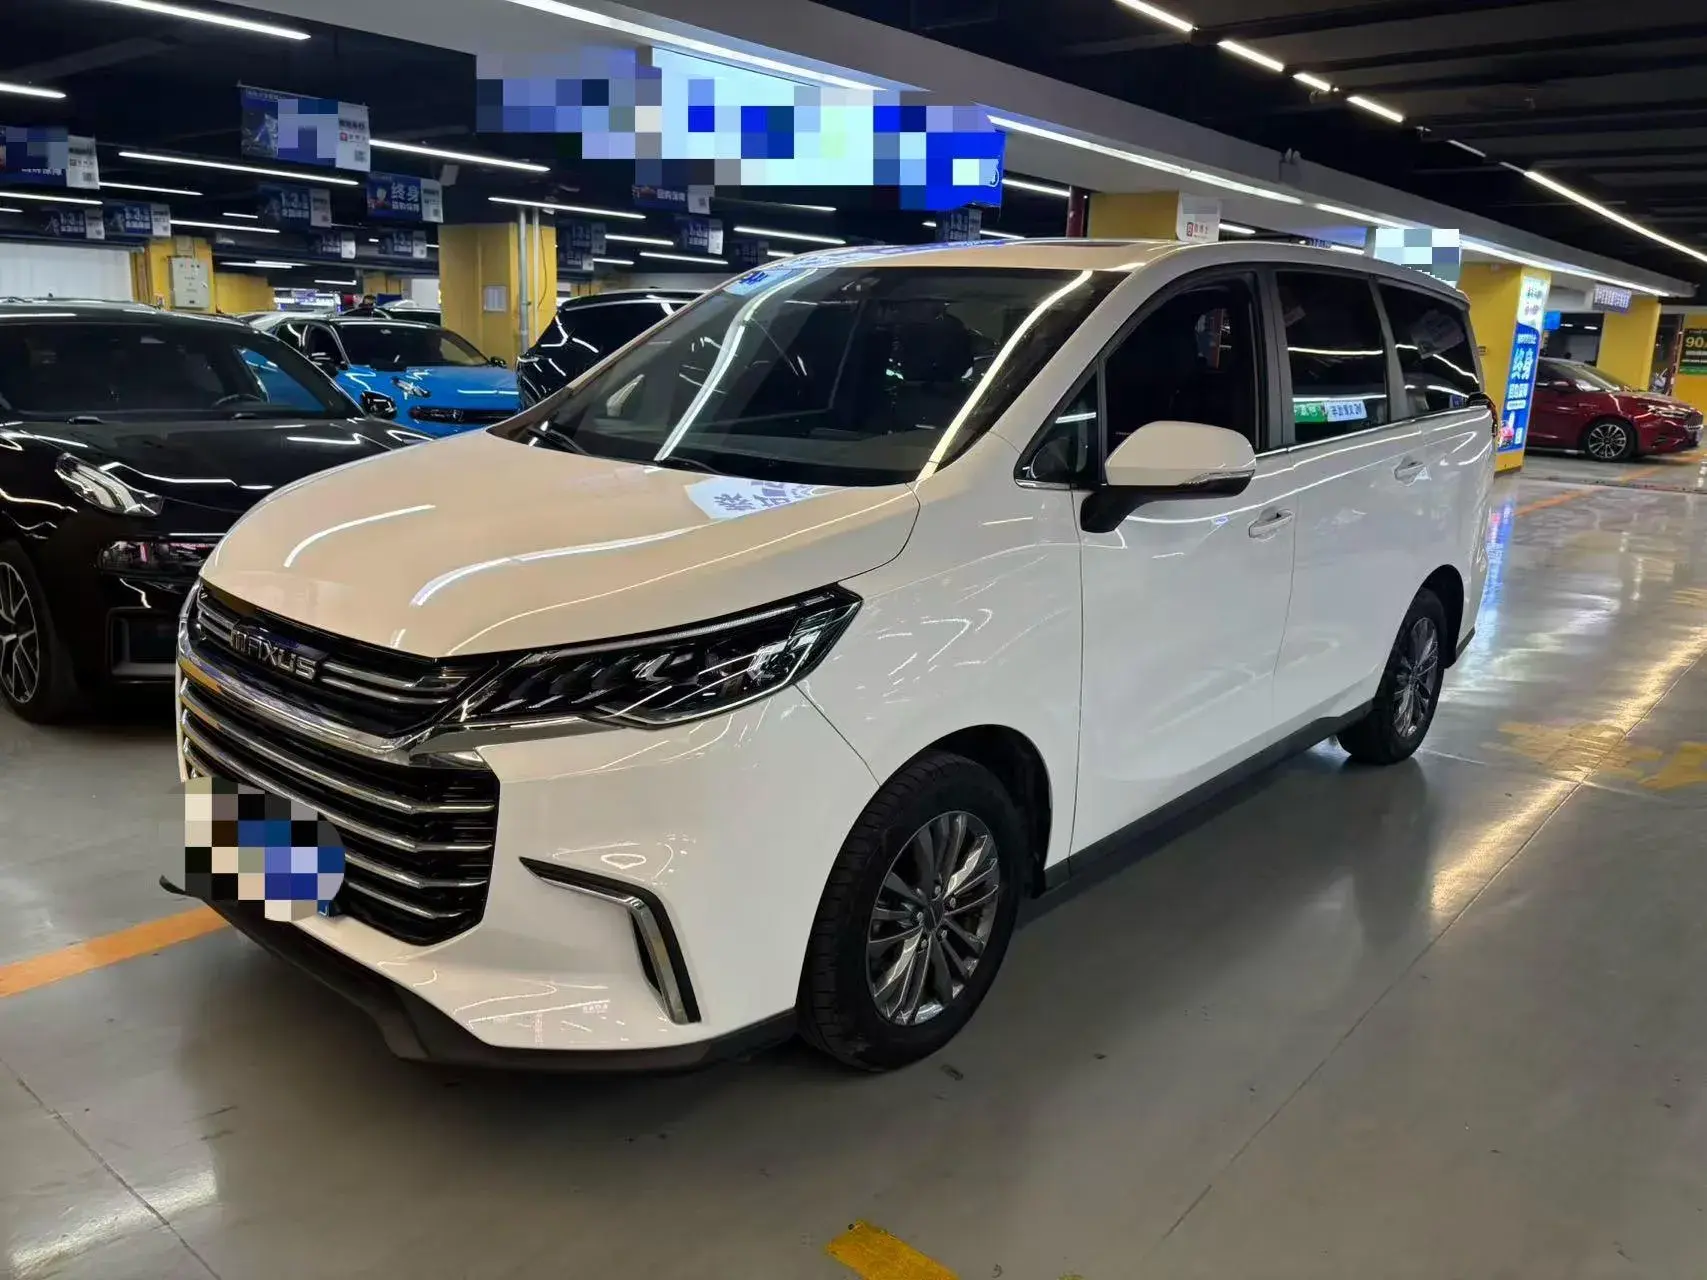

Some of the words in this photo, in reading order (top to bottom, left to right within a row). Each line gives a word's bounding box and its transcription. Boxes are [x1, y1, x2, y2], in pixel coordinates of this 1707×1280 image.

[391, 182, 419, 202] 终身
[1685, 336, 1707, 348] 90
[230, 630, 317, 681] MAXUS
